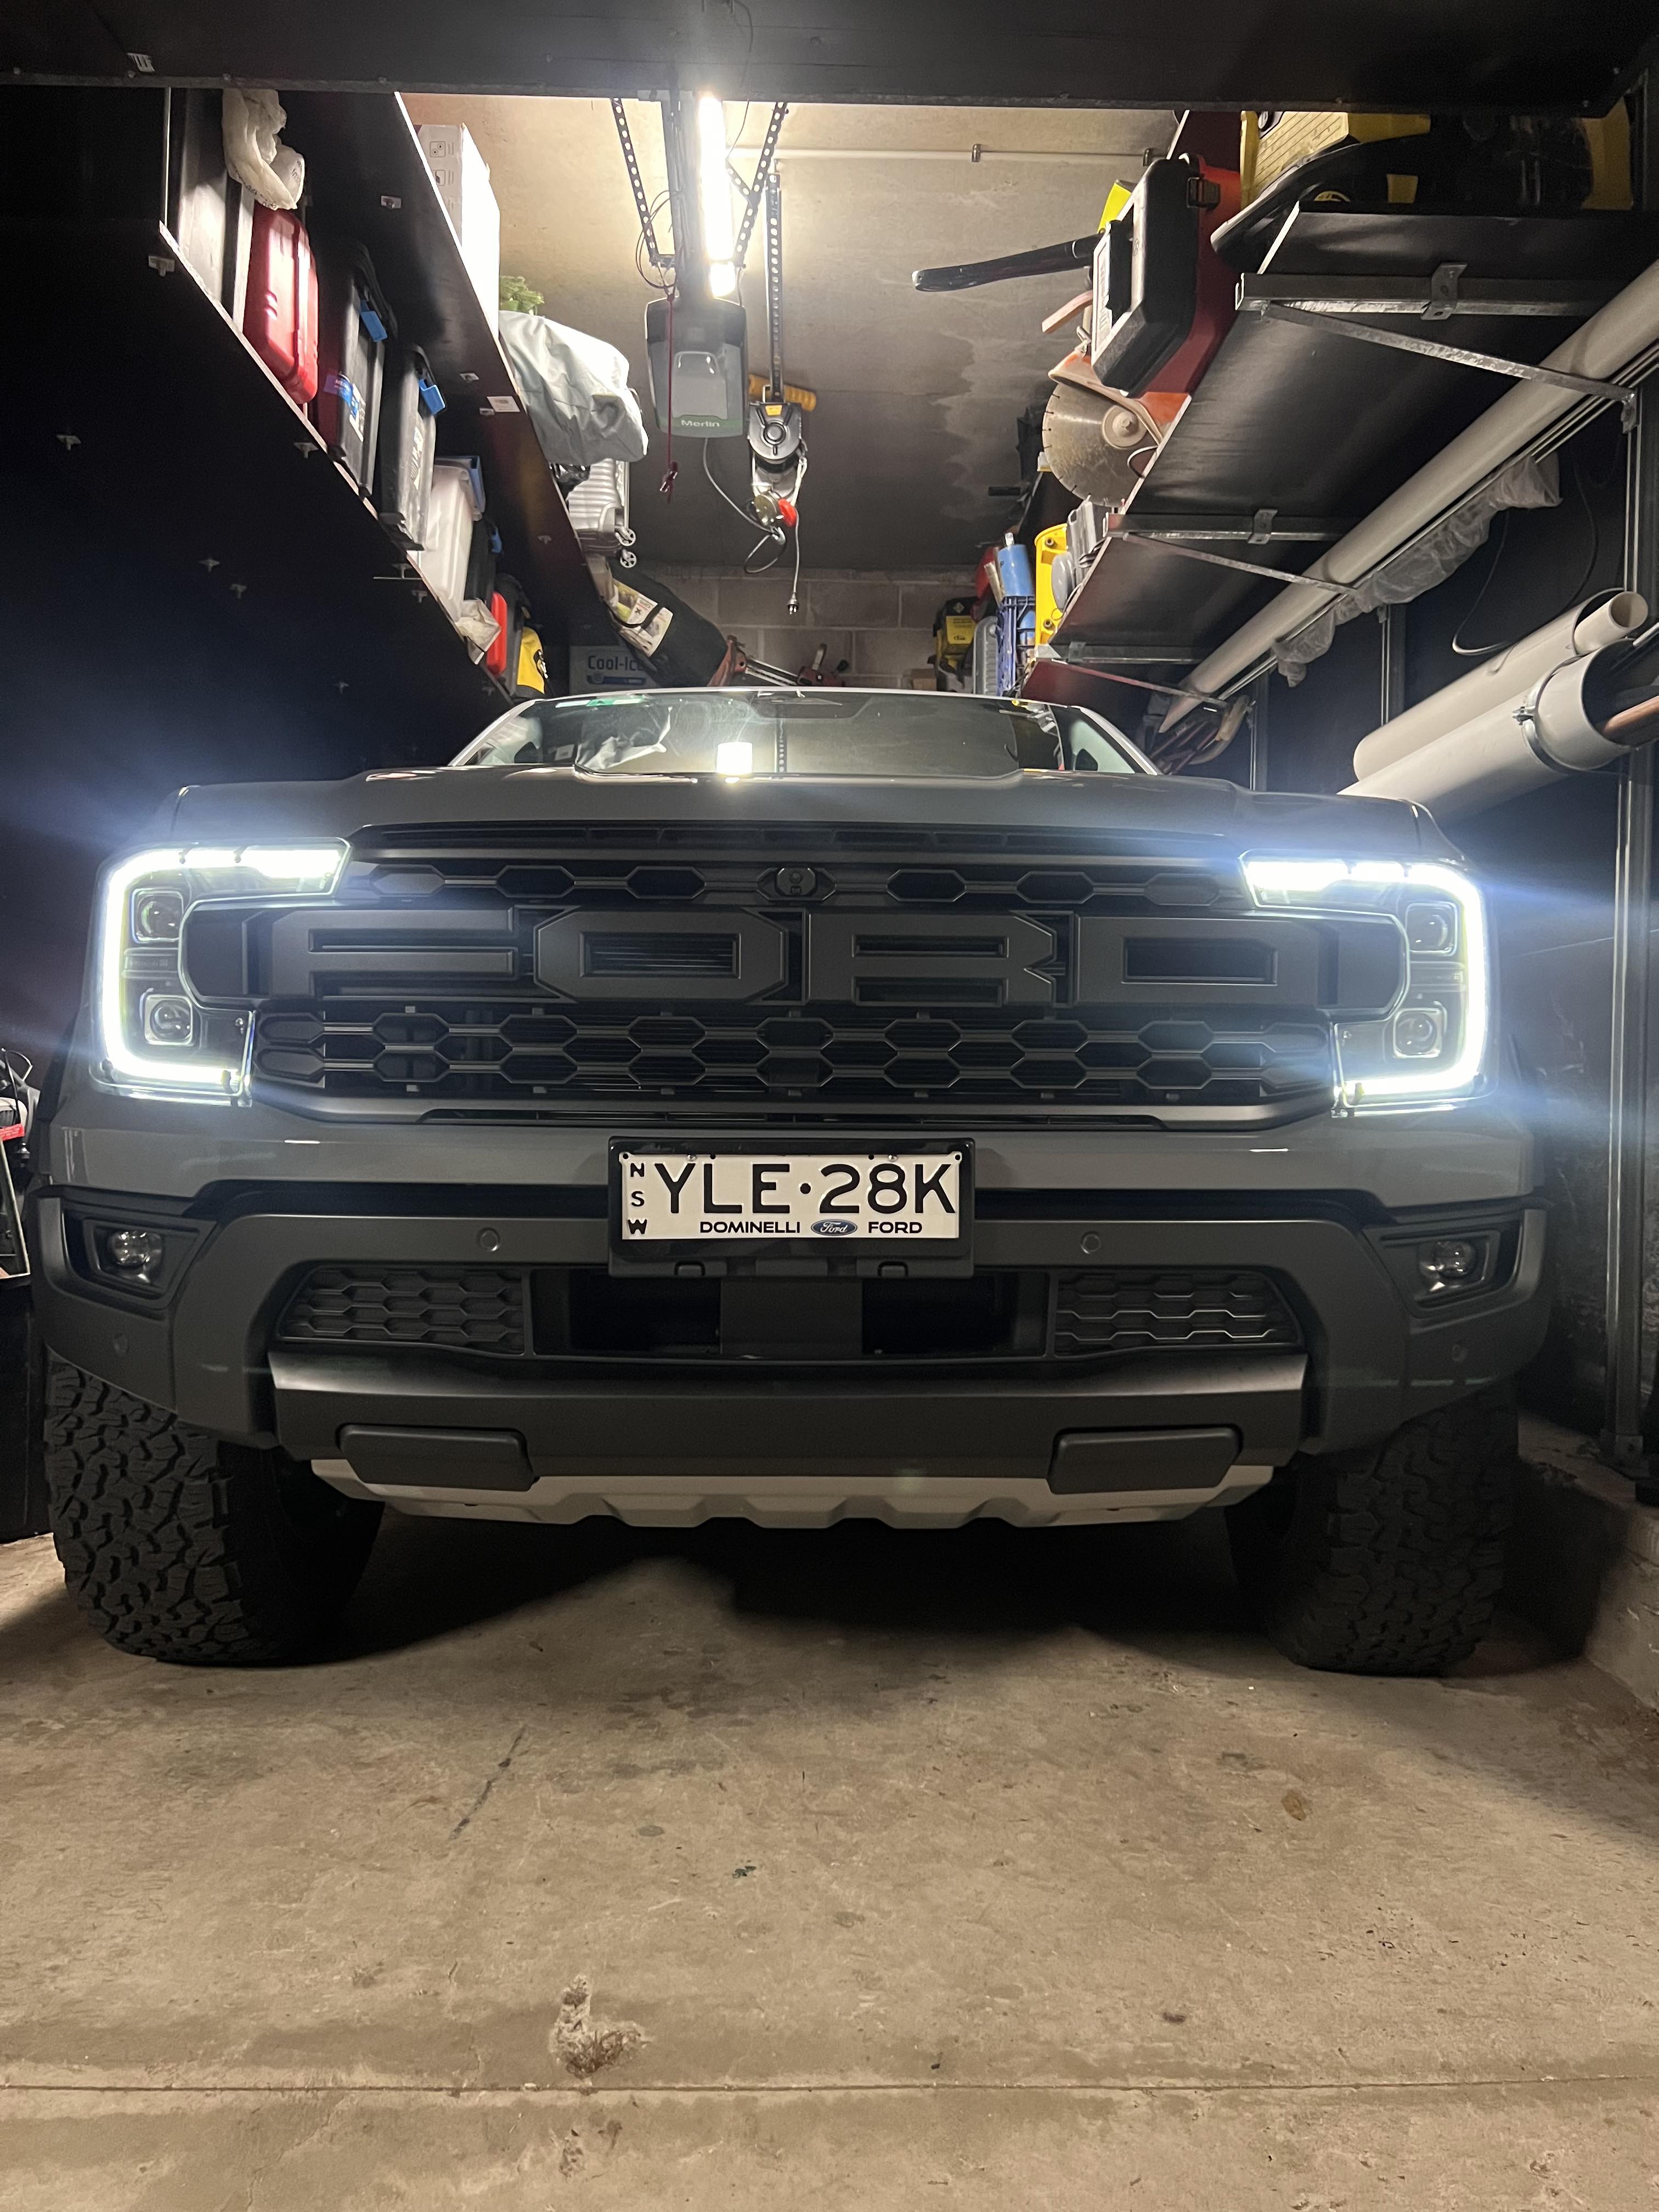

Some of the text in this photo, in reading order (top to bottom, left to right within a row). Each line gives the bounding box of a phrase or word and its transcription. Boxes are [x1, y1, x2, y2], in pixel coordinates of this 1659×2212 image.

[272, 908, 1318, 1006] FORD
[700, 1221, 923, 1234] DOMINELLI Ford FORD
